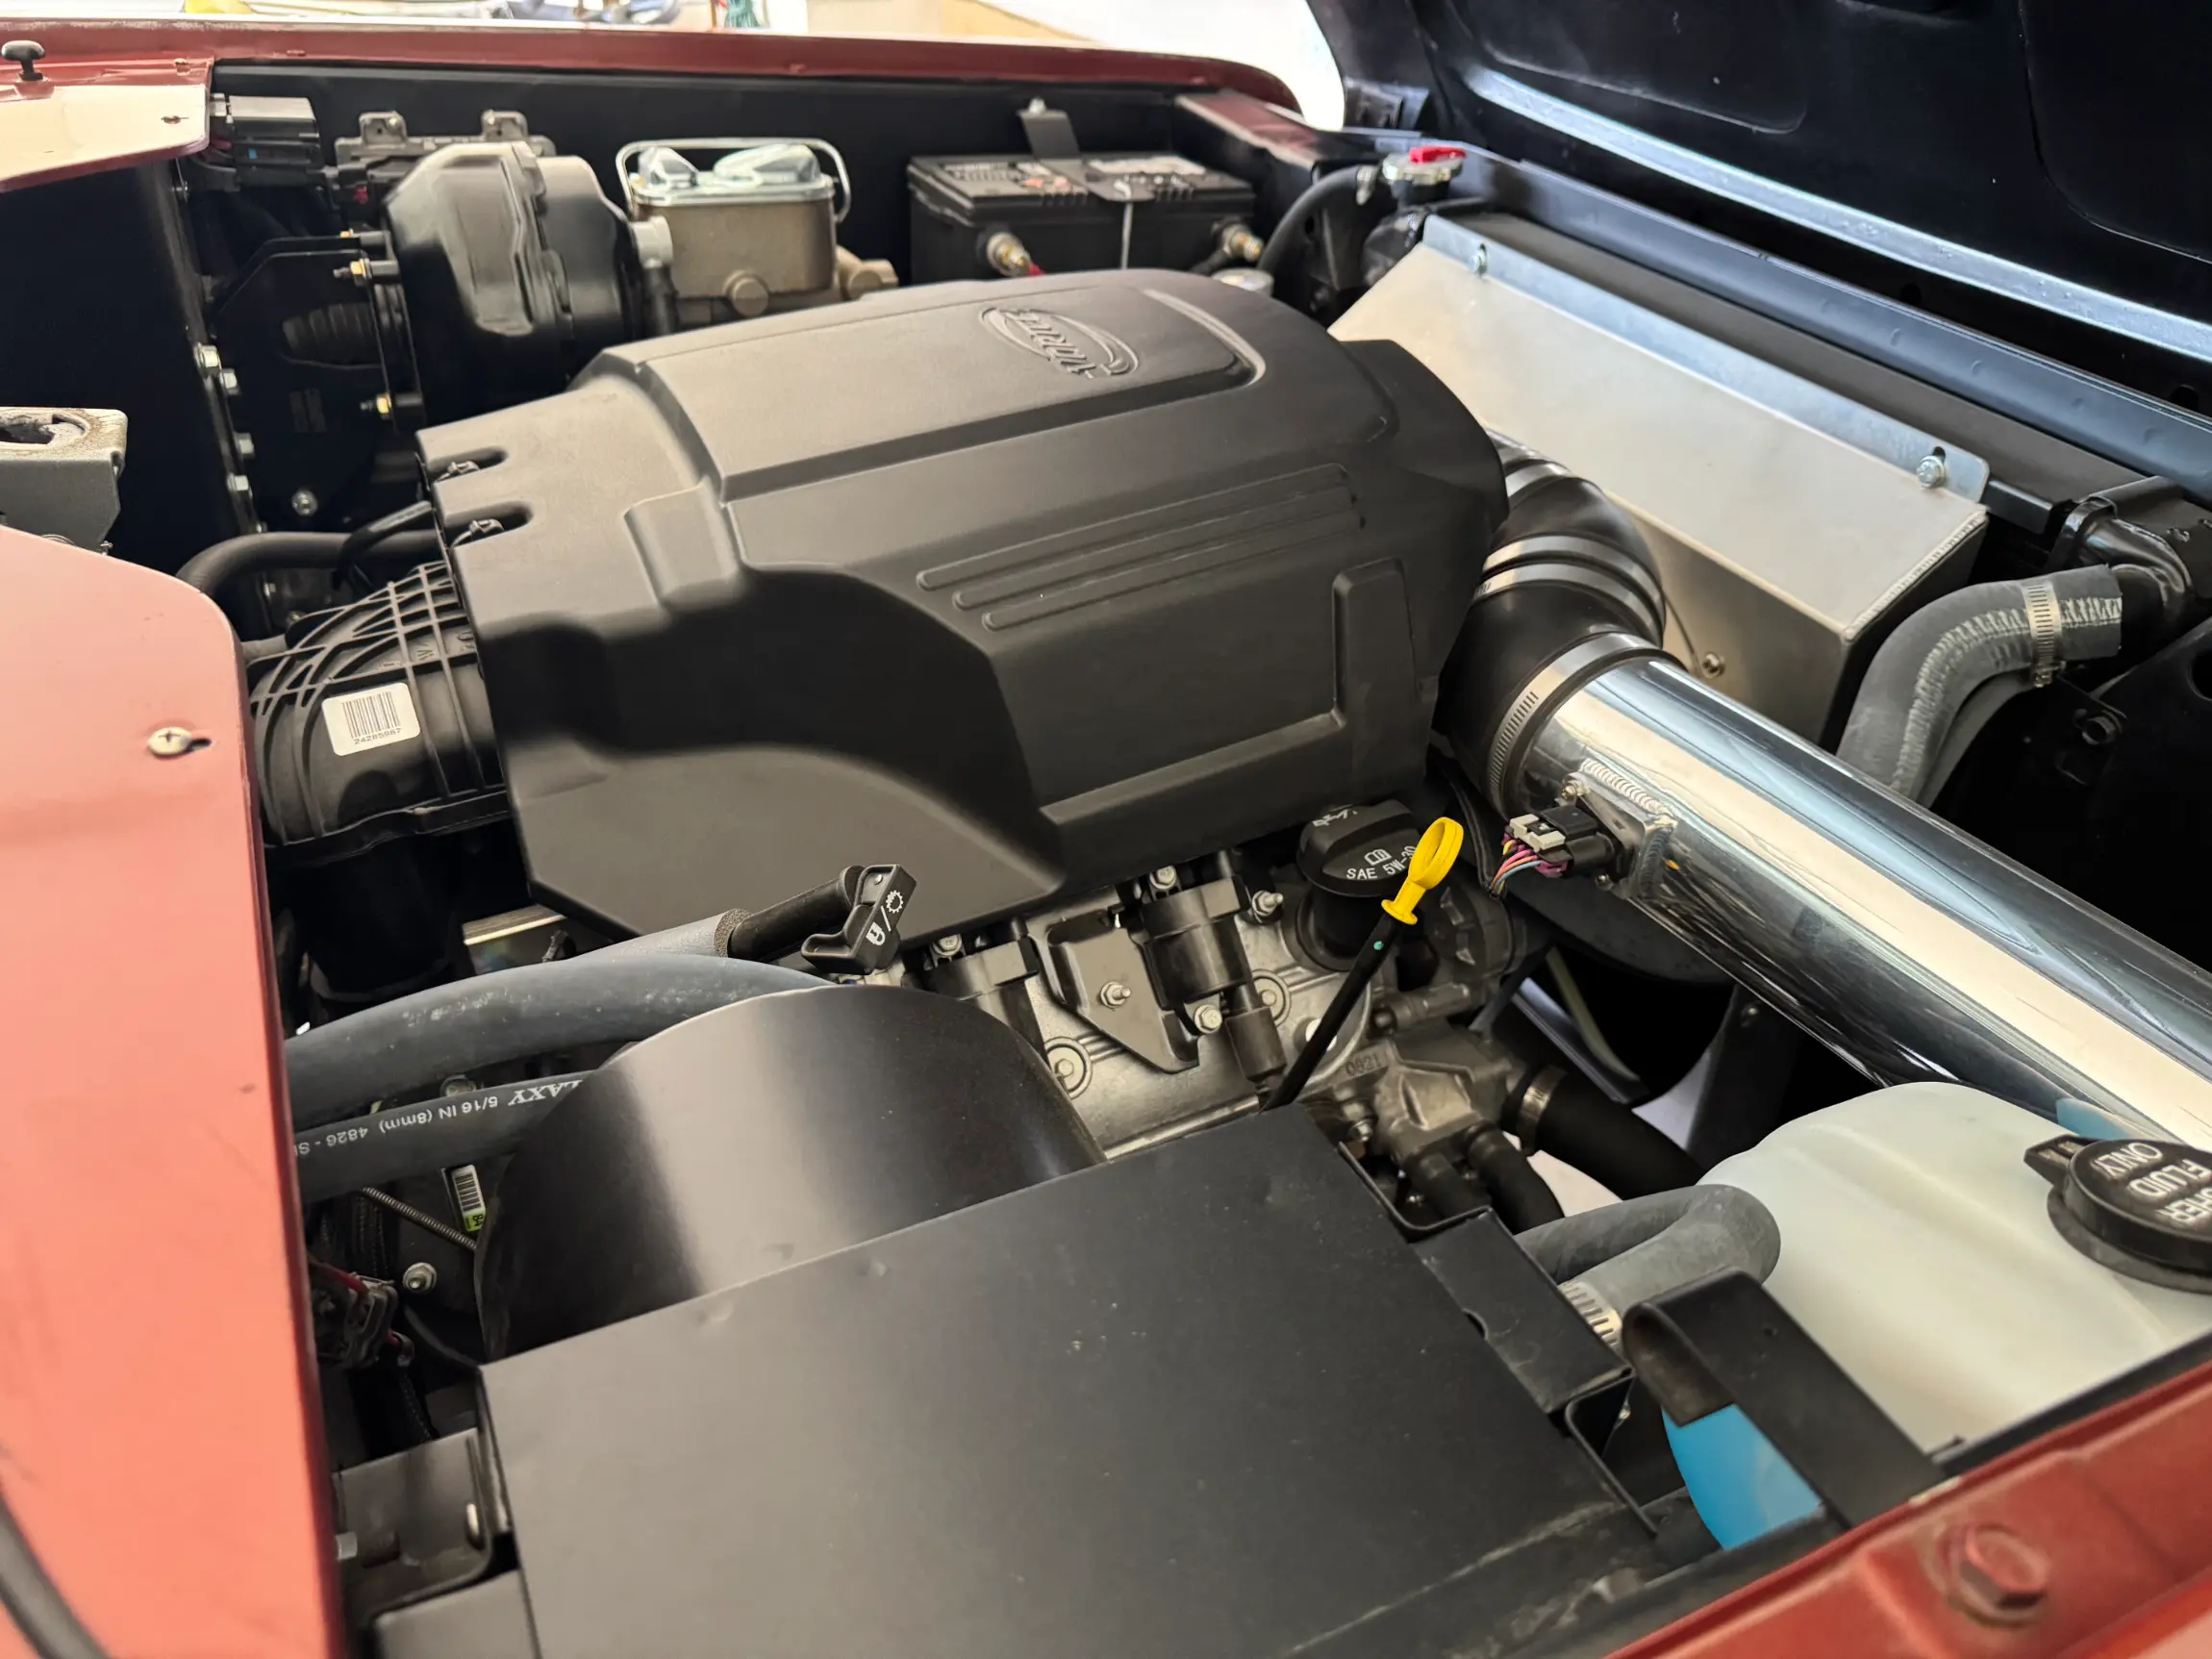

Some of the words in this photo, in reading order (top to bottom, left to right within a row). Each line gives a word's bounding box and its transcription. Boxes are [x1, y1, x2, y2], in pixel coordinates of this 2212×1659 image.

[1346, 868, 1377, 880] SAE
[439, 1105, 457, 1119] IN
[462, 1096, 498, 1114] 5/16
[379, 1109, 433, 1133] (8mm)
[326, 1127, 368, 1146] 4826
[2094, 1143, 2163, 1178] ONLY
[2128, 1159, 2212, 1197] FLUID
